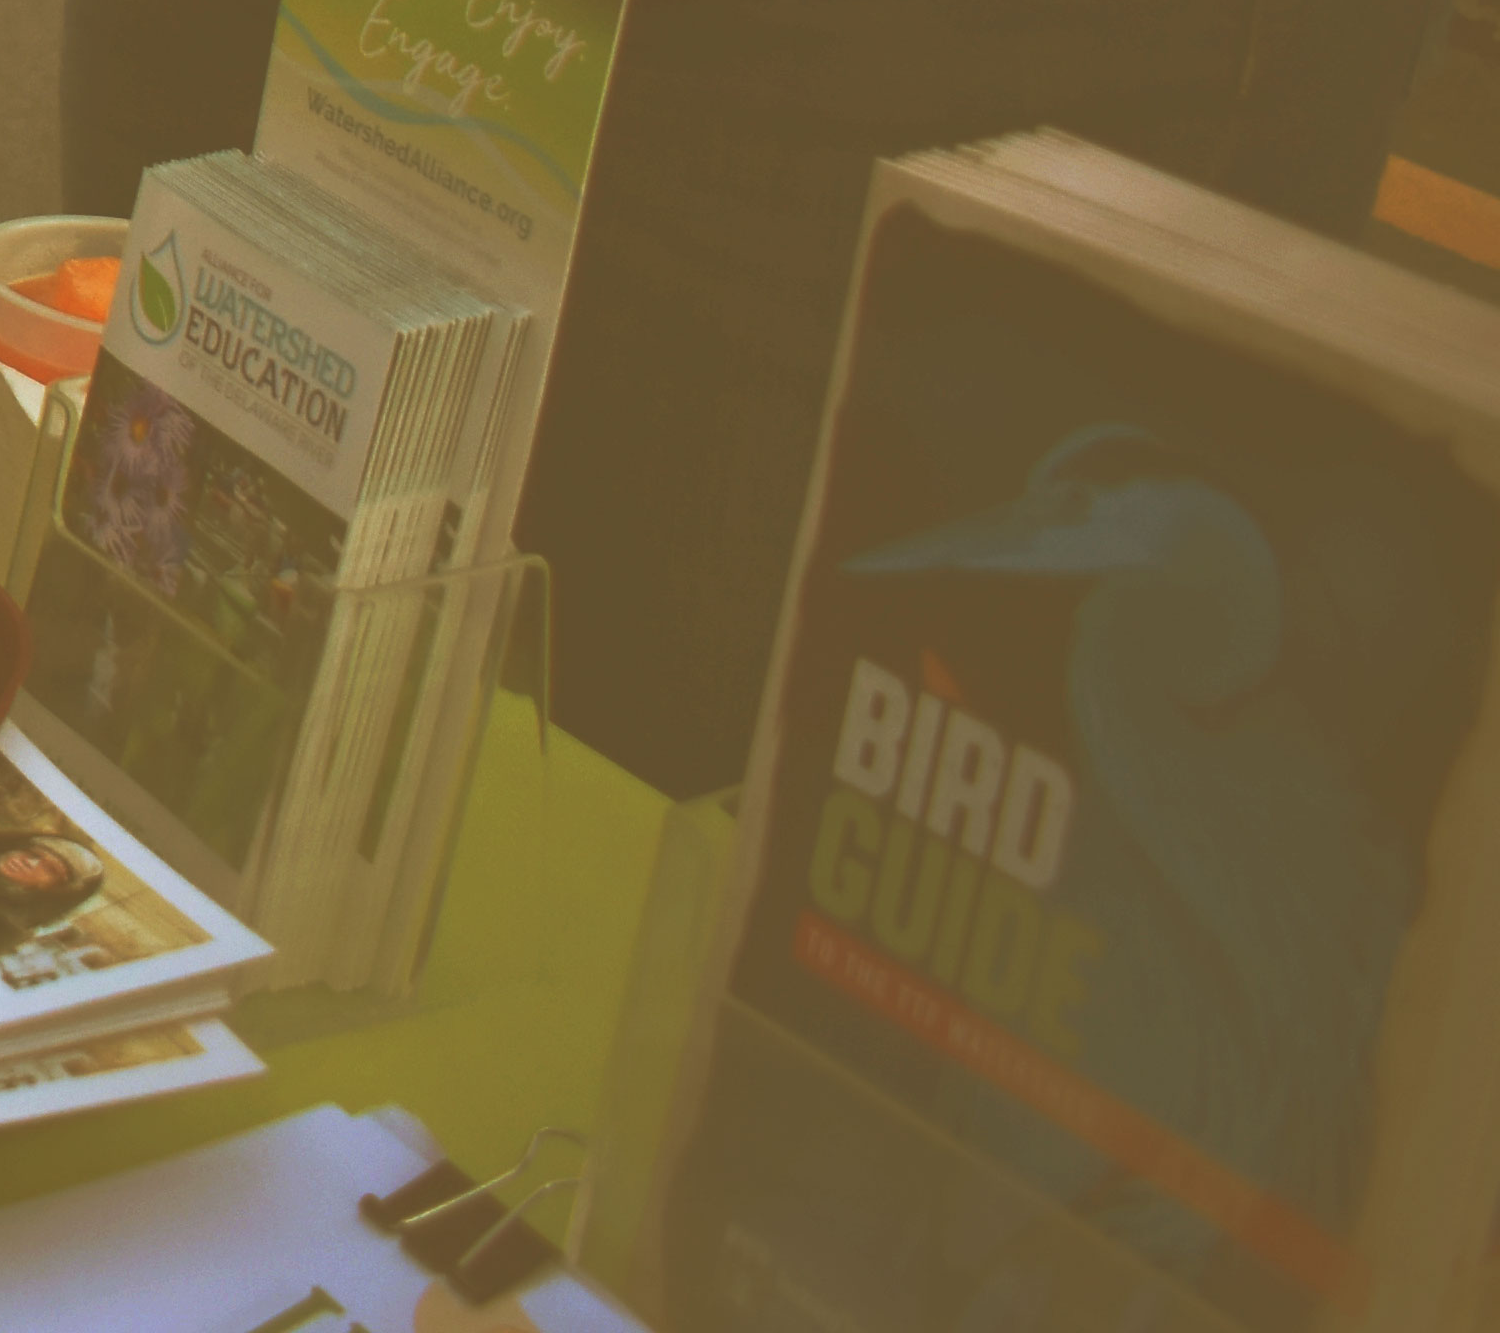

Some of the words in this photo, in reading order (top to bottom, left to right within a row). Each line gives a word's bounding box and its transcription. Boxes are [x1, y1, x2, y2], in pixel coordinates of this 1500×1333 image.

[306, 84, 533, 241] WatershedAlliance.org
[184, 305, 351, 443] EDUCATION
[191, 267, 359, 400] WATERSHED
[832, 656, 1074, 890] BIRD
[808, 790, 1104, 1065] GUIDE
